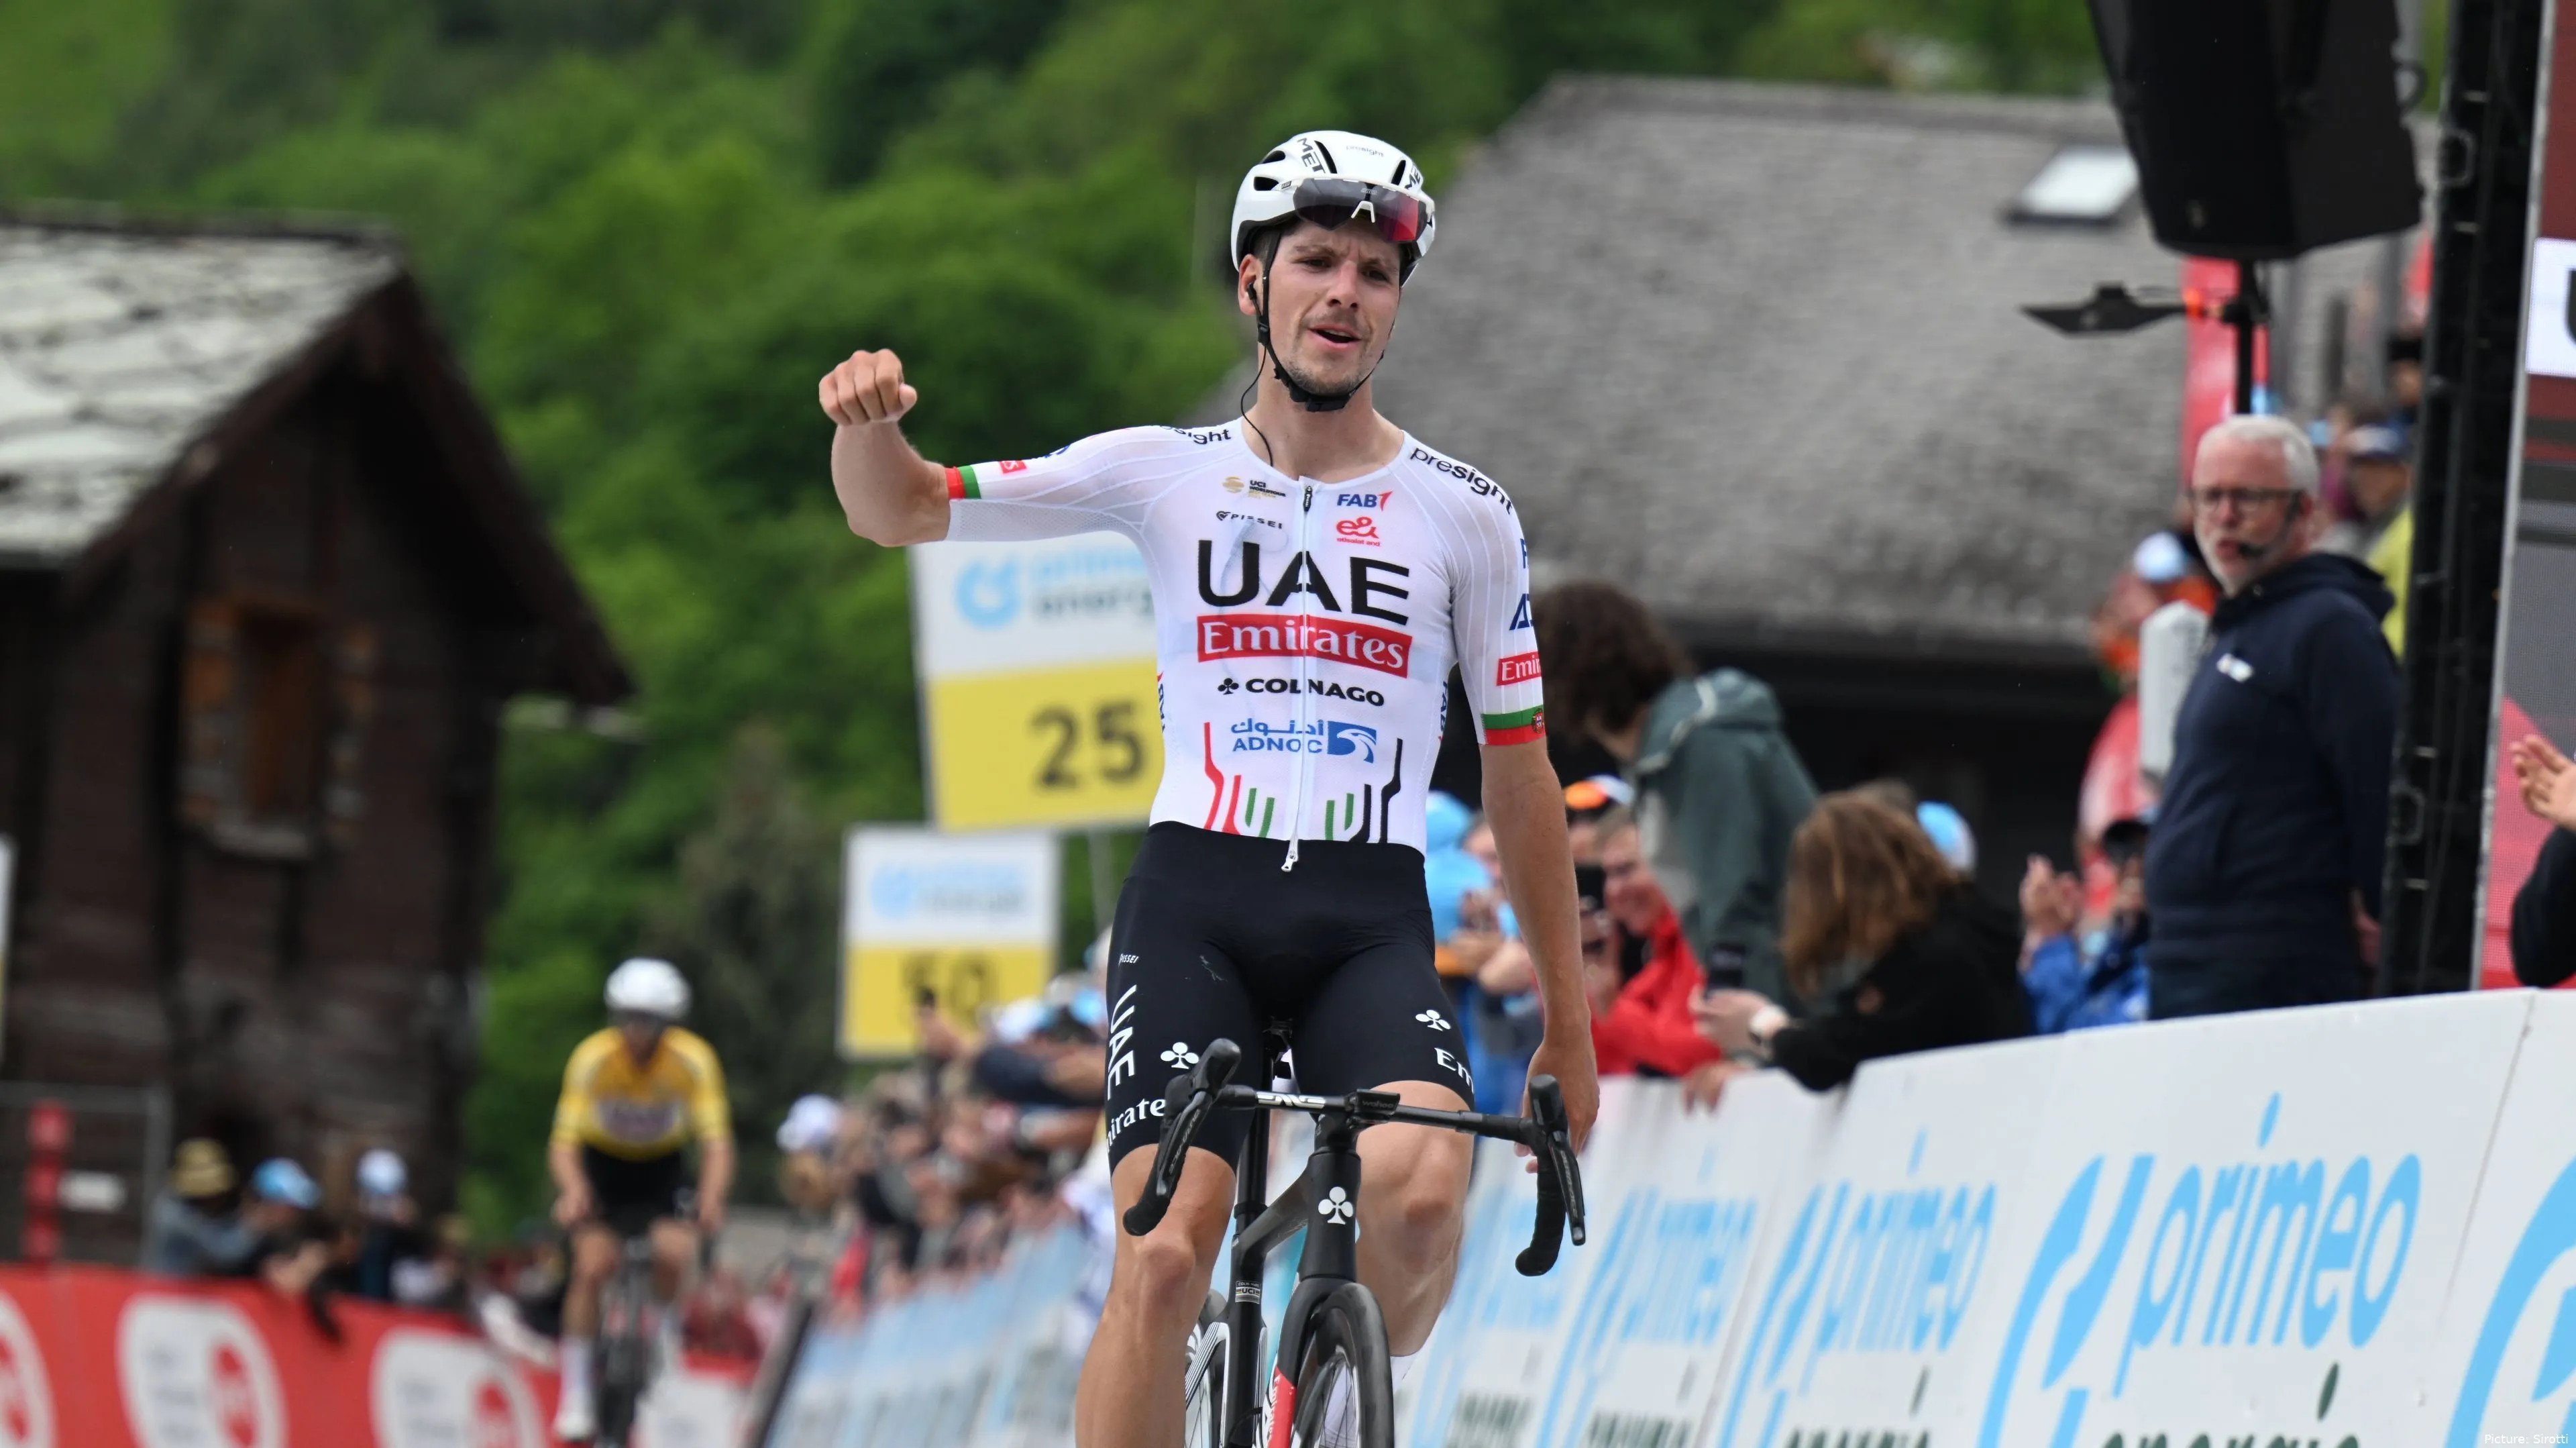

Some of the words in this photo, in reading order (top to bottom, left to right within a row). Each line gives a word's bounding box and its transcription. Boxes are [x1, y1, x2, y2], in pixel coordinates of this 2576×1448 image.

[1296, 137, 1326, 174] MET
[1249, 480, 1267, 488] UCI
[1410, 446, 1513, 515] presight
[1197, 539, 1409, 626] UAE
[1203, 621, 1405, 669] Emirates
[1245, 678, 1385, 707] COLNAGO
[1028, 701, 1146, 788] 25
[1232, 737, 1323, 754] ADNOC
[1107, 984, 1137, 1101] UAE
[1362, 1098, 1395, 1108] wahoo
[2112, 1091, 2422, 1400] primeo
